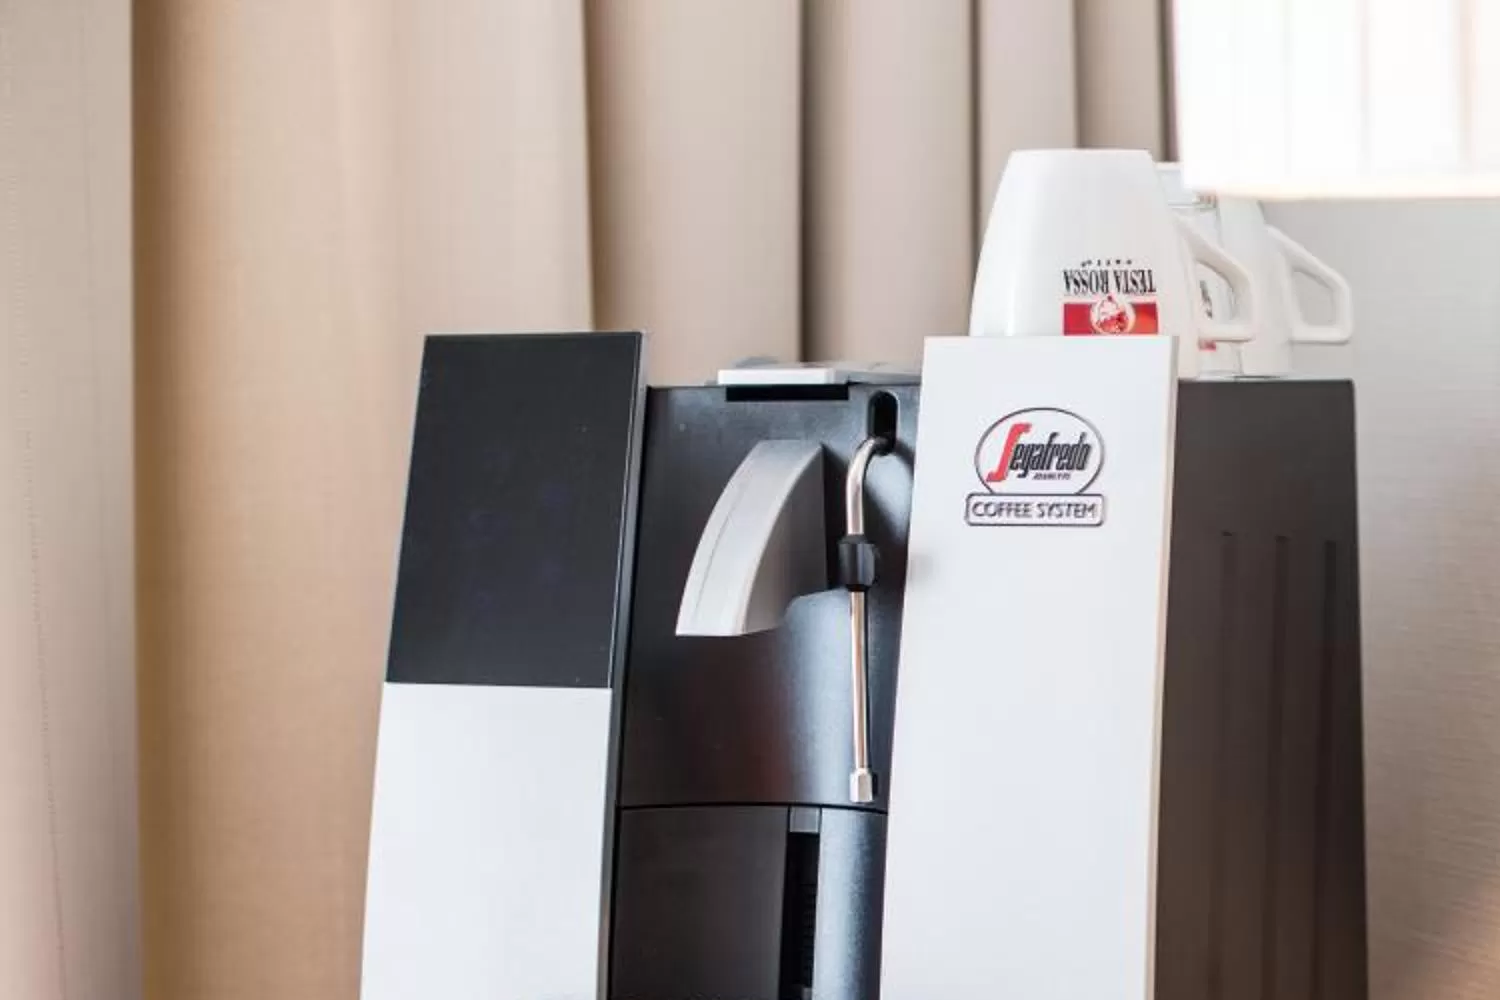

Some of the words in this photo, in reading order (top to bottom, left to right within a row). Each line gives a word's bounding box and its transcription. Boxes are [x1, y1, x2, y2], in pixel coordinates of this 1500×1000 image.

[1063, 269, 1110, 295] ROSSA
[1113, 269, 1157, 294] TESTA
[985, 422, 1093, 482] Segafredo
[971, 501, 1033, 518] COFFEE
[1036, 502, 1097, 519] SYSTEM
